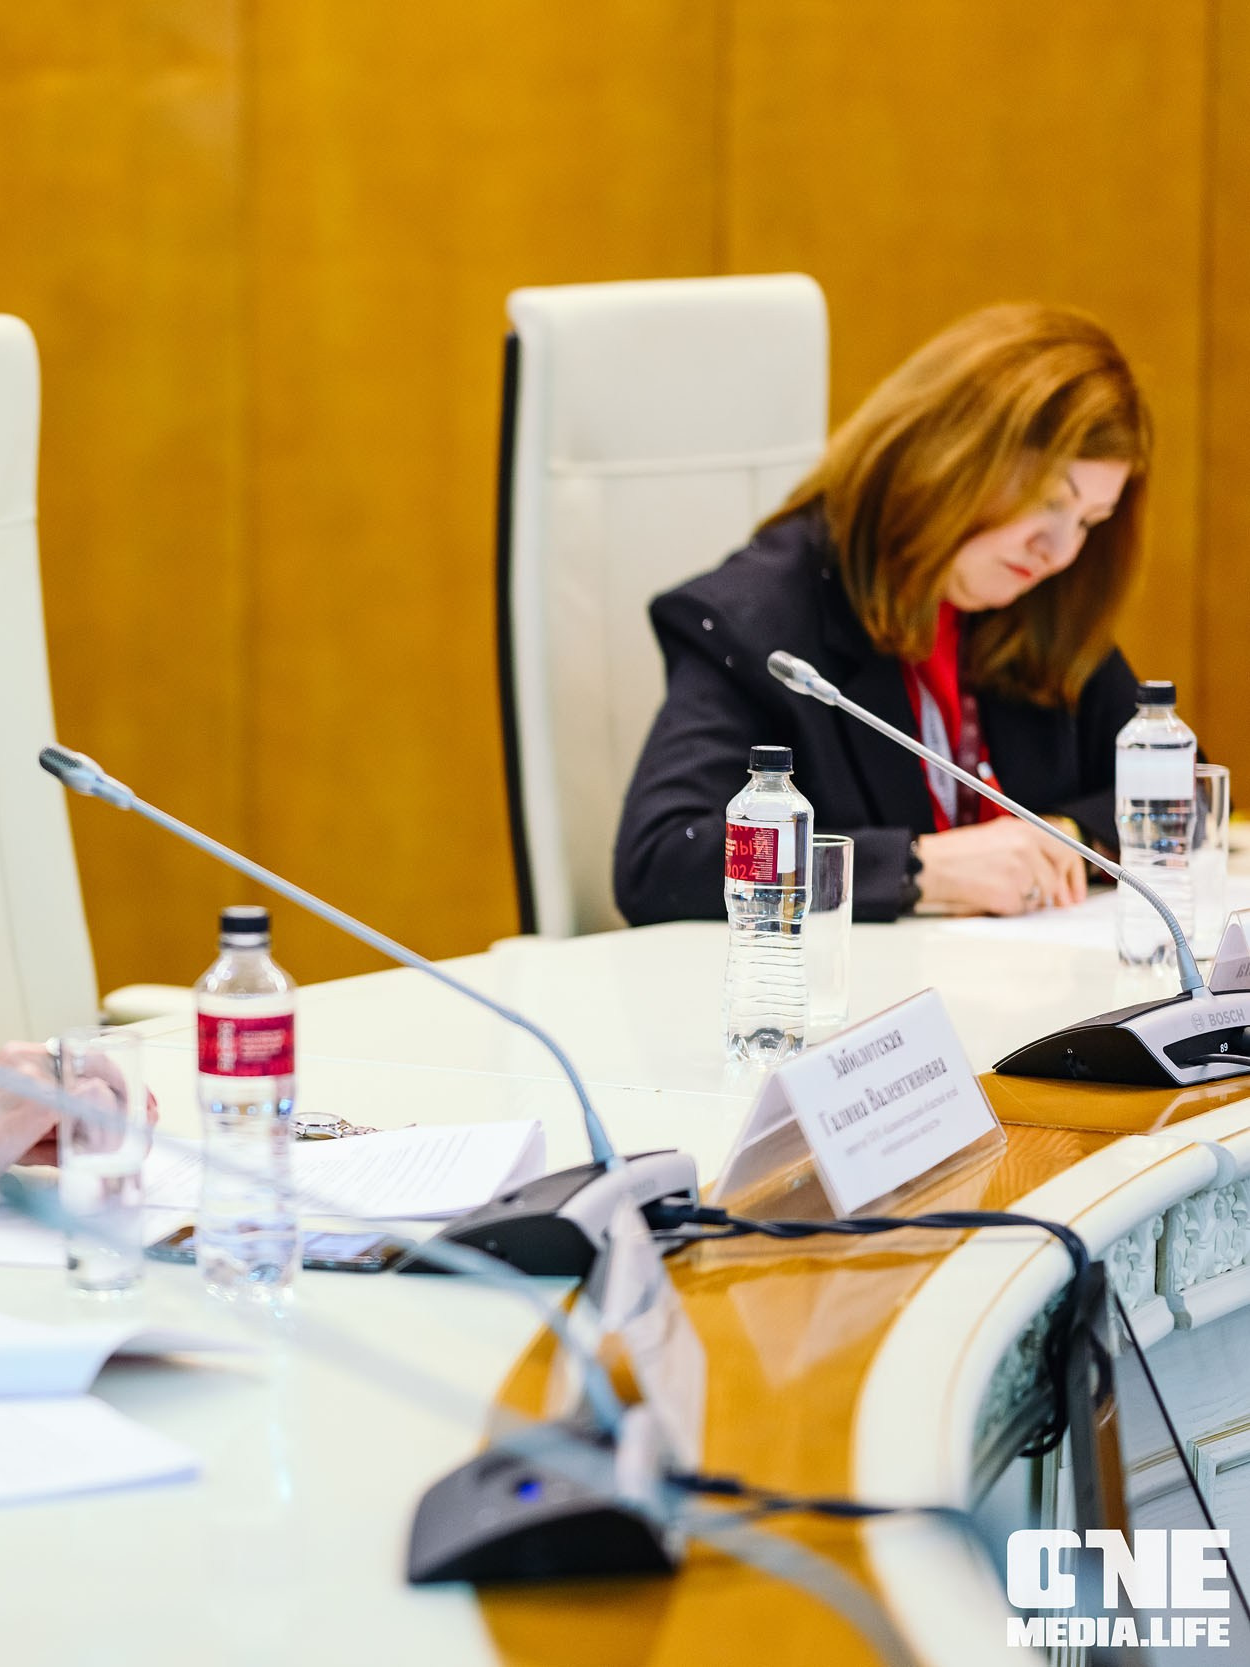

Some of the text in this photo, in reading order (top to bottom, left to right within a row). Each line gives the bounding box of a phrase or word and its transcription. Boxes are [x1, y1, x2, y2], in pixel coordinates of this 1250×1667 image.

[1208, 1008, 1245, 1027] BOSCH
[818, 1100, 869, 1137] Галина
[864, 1057, 947, 1111] Валентиновна
